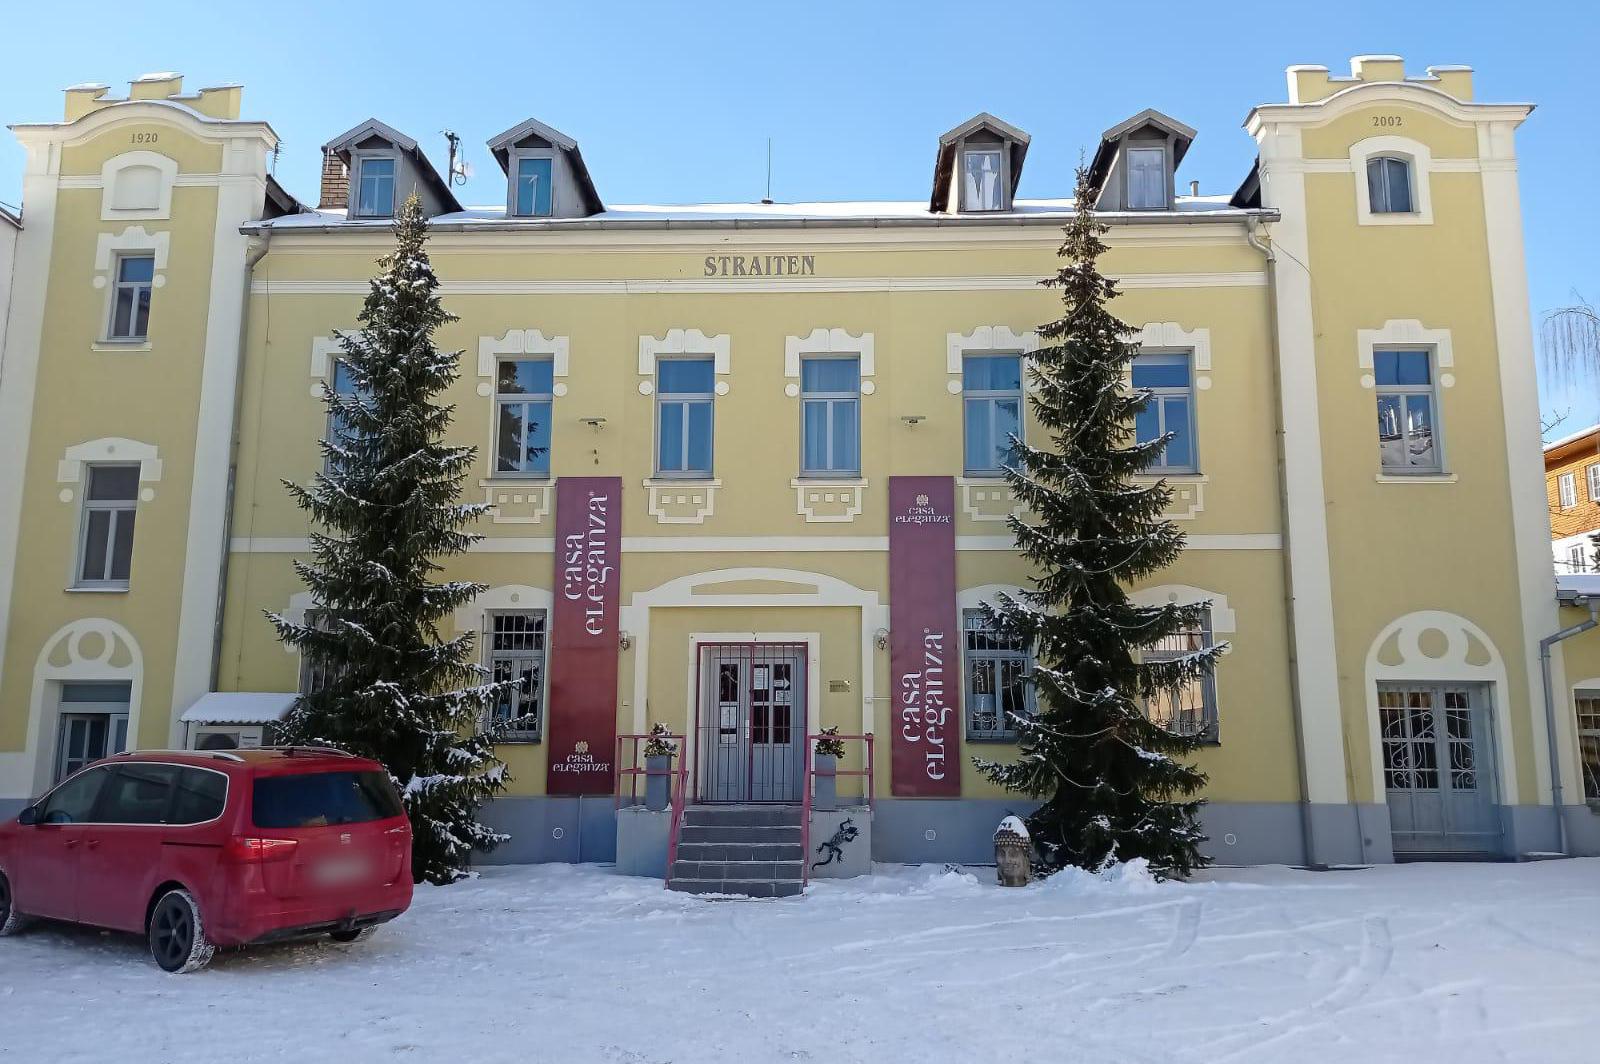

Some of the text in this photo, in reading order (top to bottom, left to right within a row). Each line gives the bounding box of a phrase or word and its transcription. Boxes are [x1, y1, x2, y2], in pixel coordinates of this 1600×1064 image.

[1372, 115, 1403, 127] 2002
[129, 132, 158, 144] 1920
[703, 255, 816, 277] STRAITEN
[908, 507, 935, 515] casa
[563, 531, 585, 601] casa
[901, 670, 922, 743] casa
[566, 754, 593, 763] casa
